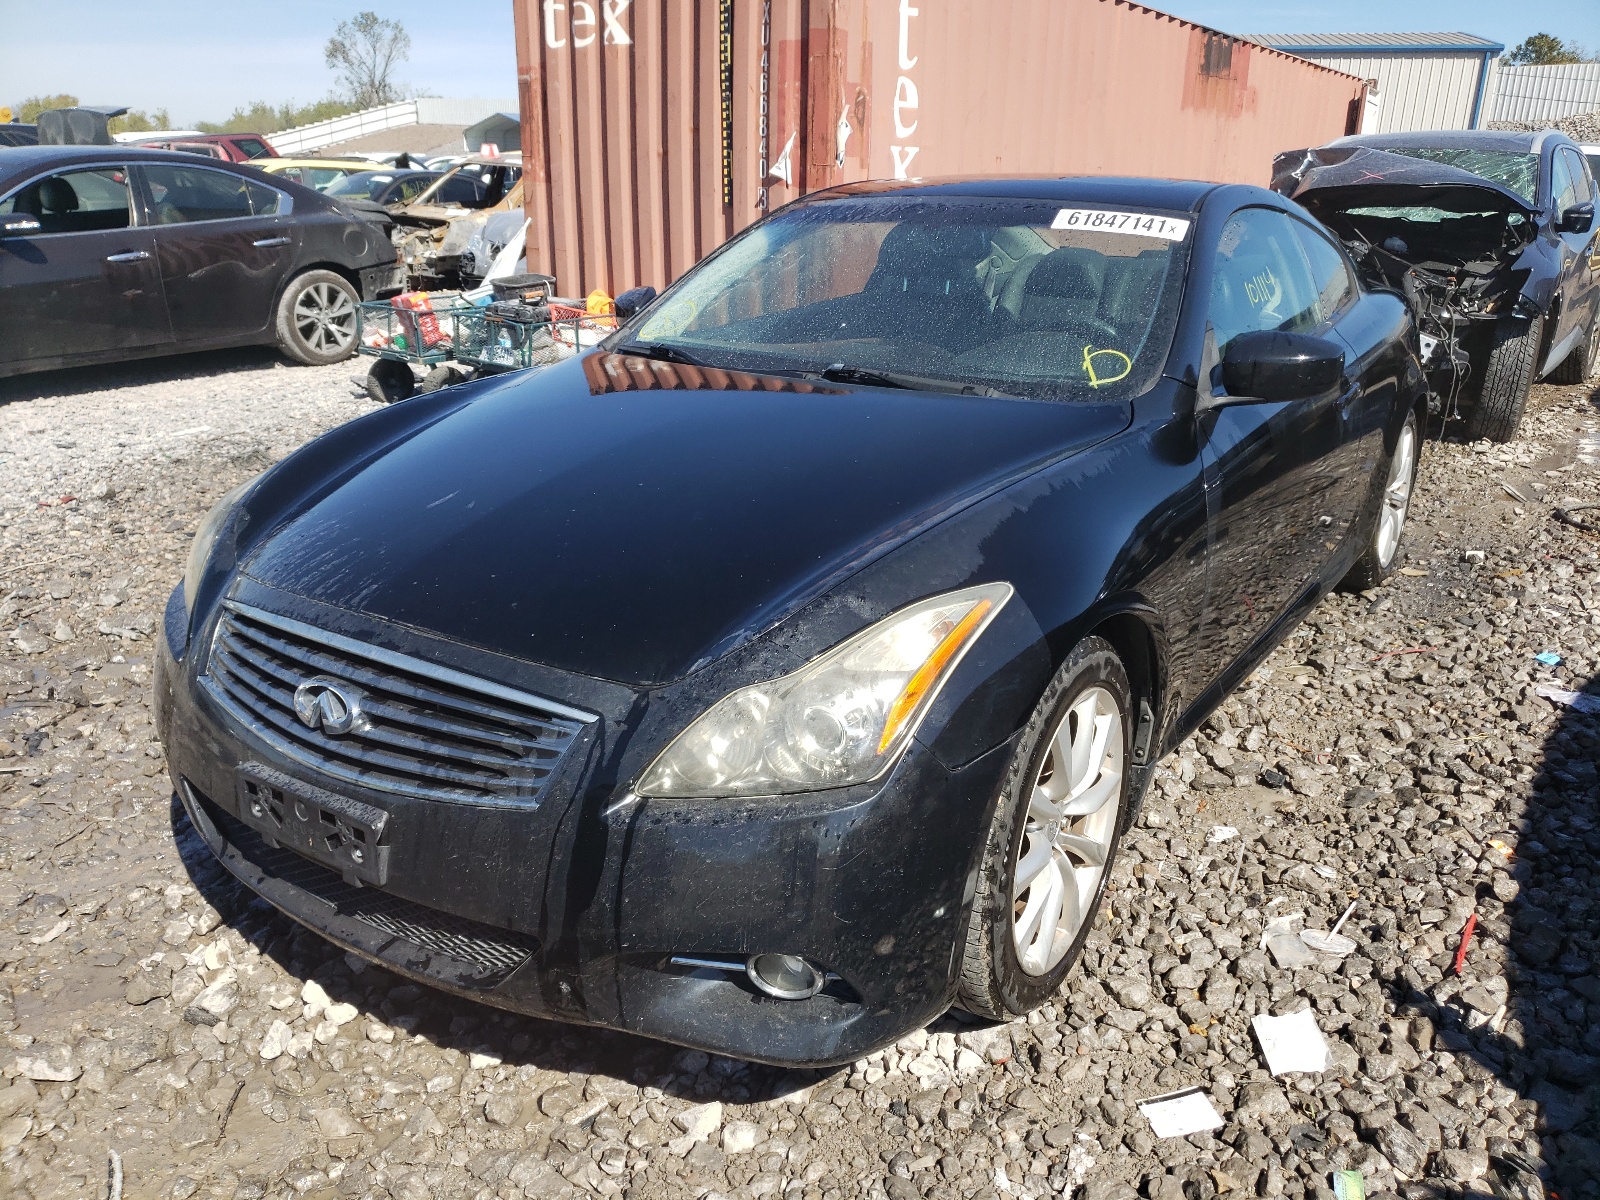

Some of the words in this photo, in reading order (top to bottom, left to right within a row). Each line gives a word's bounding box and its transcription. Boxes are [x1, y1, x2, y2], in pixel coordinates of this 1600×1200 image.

[543, 0, 633, 47] tex
[758, 50, 769, 179] 466840
[759, 188, 768, 209] 3
